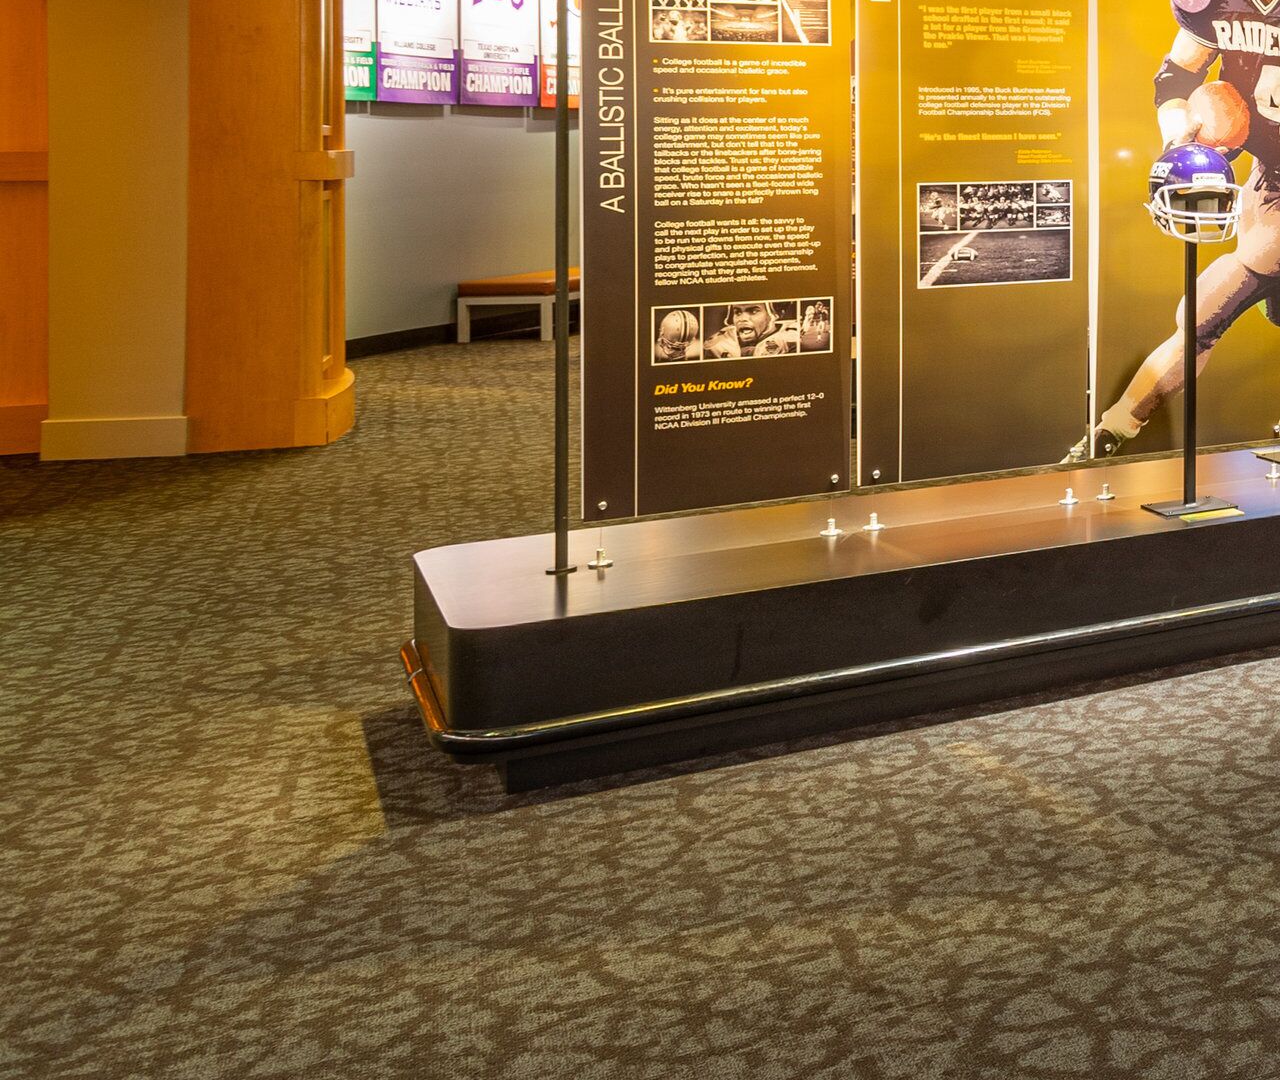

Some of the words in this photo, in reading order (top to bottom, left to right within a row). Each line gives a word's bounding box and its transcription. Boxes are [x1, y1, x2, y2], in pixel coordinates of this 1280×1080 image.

[662, 57, 692, 66] College
[694, 58, 722, 66] football
[382, 67, 452, 92] CHAMPION
[466, 73, 533, 95] CHAMPION
[598, 68, 625, 188] BALLISTIC
[600, 196, 625, 213] A
[654, 383, 679, 396] Did
[681, 382, 706, 393] You
[708, 377, 753, 391] Know?
[654, 404, 697, 414] Wittenberg
[699, 400, 736, 410] University
[737, 396, 771, 406] amassed
[779, 394, 805, 404] perfect
[654, 413, 680, 422] record
[682, 412, 689, 420] in
[691, 410, 710, 419] 1973
[723, 408, 743, 416] route
[753, 404, 782, 414] winning
[783, 402, 796, 411] the
[796, 401, 812, 409] first
[654, 421, 679, 430] NCAA
[680, 419, 711, 428] Division
[712, 417, 720, 425] III
[721, 416, 752, 424] Football
[752, 411, 808, 421] Championship.
